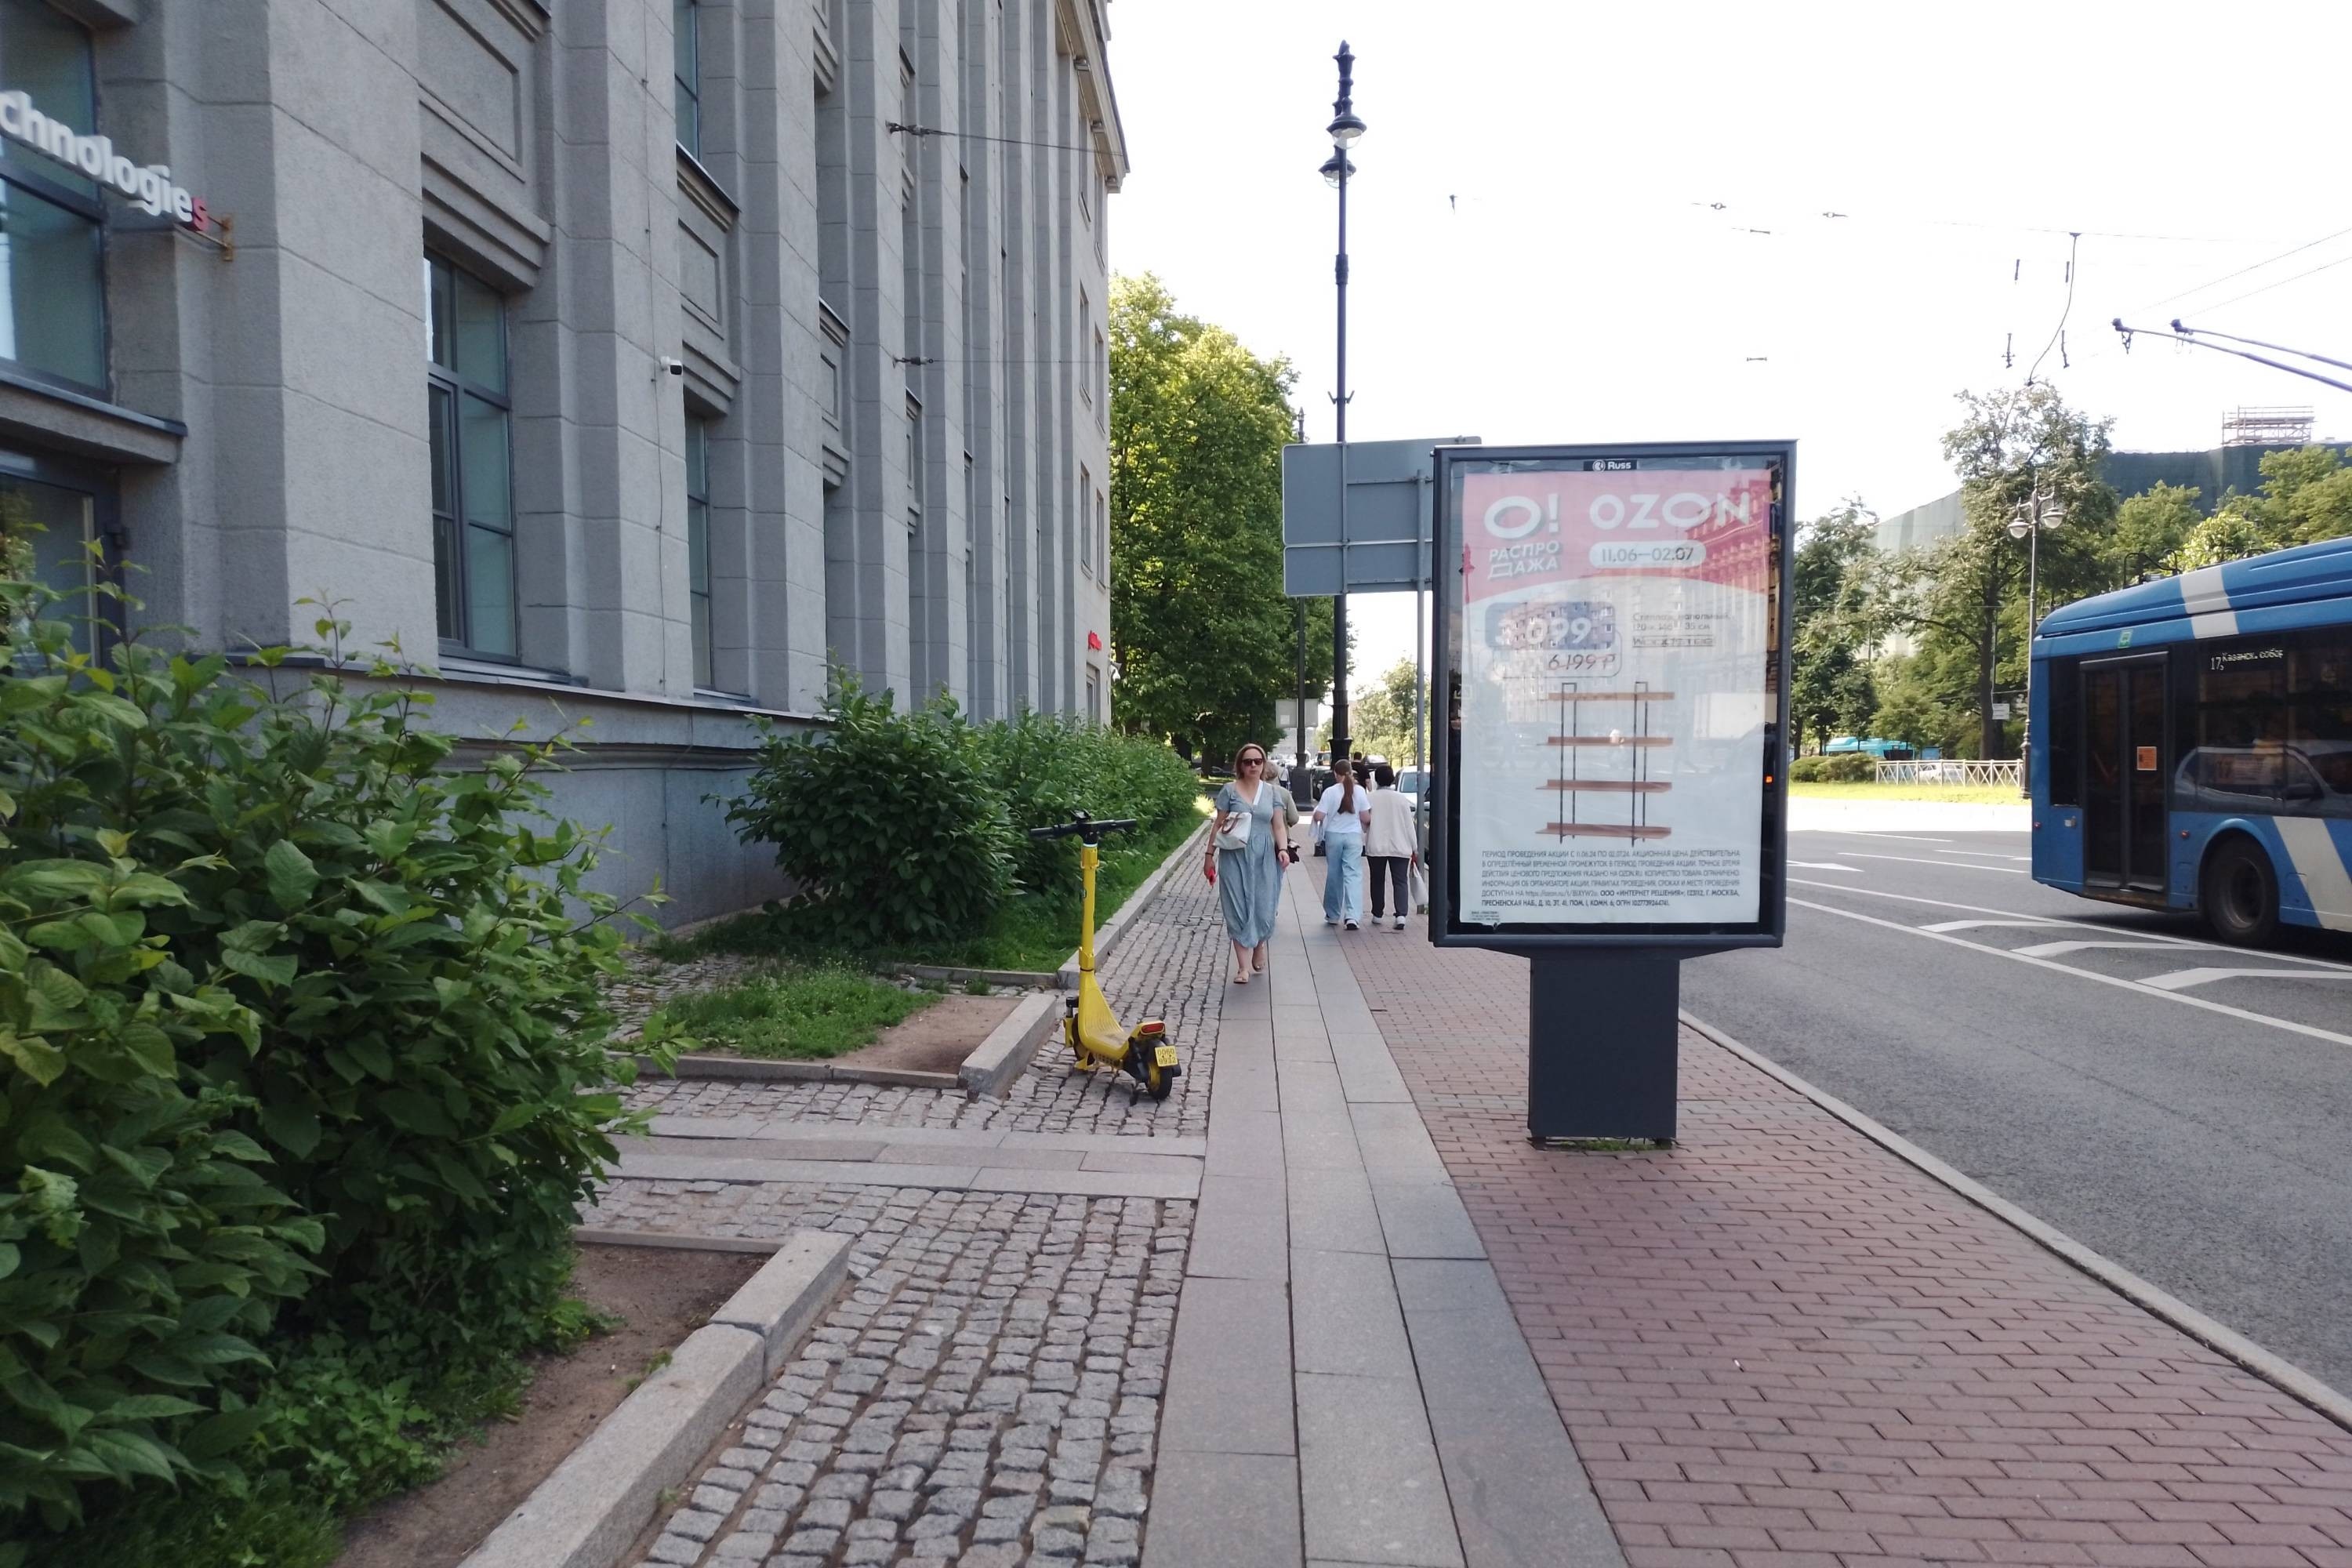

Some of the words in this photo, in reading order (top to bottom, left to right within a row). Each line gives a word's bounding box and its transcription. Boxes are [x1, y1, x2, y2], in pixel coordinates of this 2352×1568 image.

[1607, 460, 1632, 470] Russ
[1589, 492, 1750, 530] OZON
[1489, 540, 1560, 561] РАСПРО
[1488, 557, 1560, 579] ДАЖА
